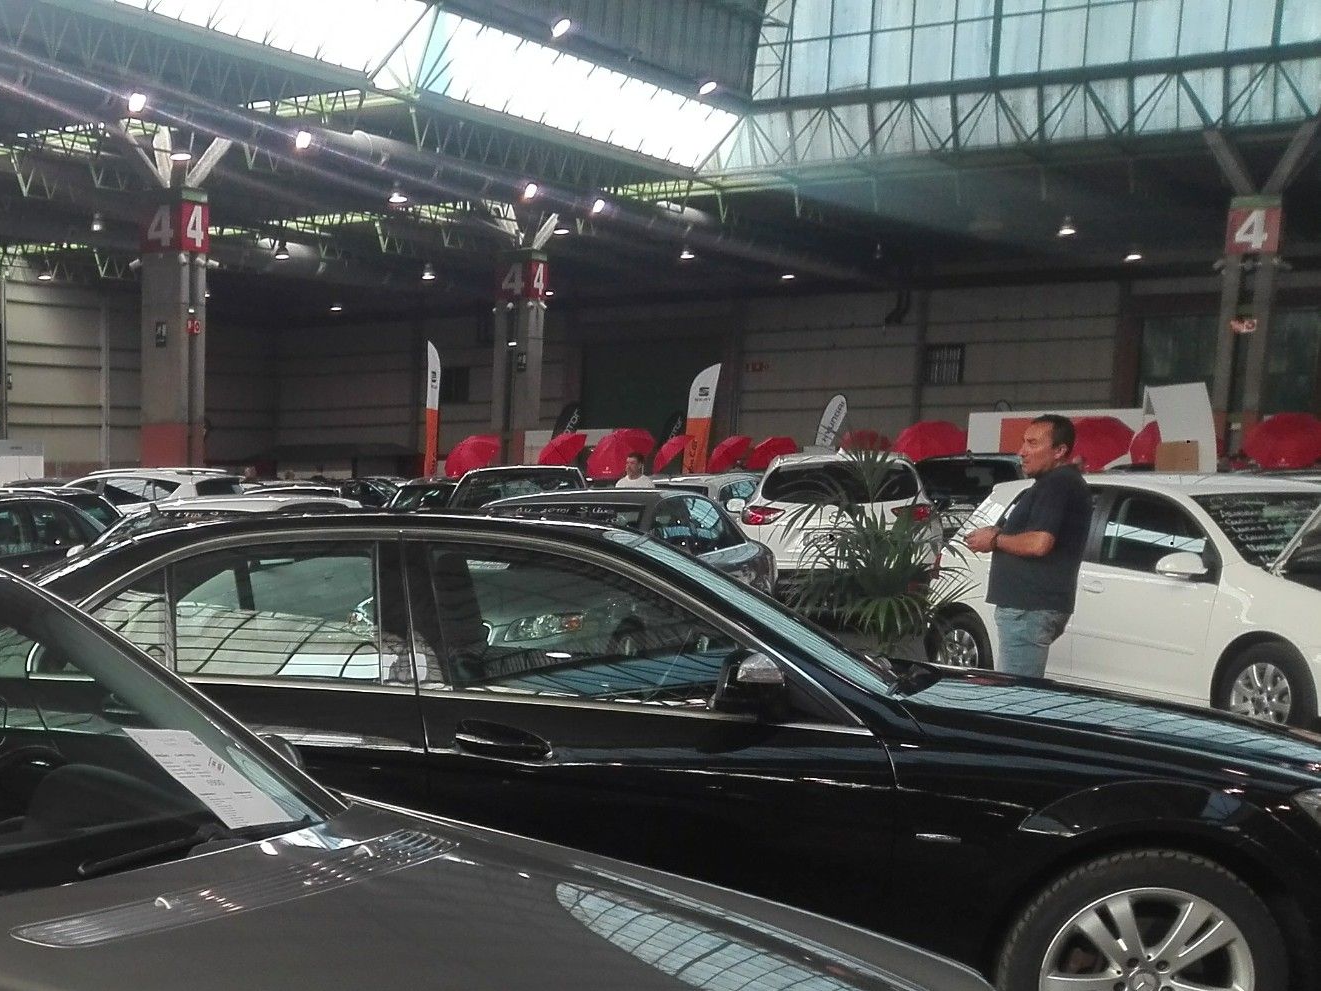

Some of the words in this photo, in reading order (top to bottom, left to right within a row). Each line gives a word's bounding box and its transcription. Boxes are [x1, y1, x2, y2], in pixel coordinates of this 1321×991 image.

[147, 204, 174, 247] 4
[186, 204, 204, 248] 4
[1234, 208, 1268, 249] 4
[501, 261, 525, 295] 4
[533, 262, 544, 296] 4
